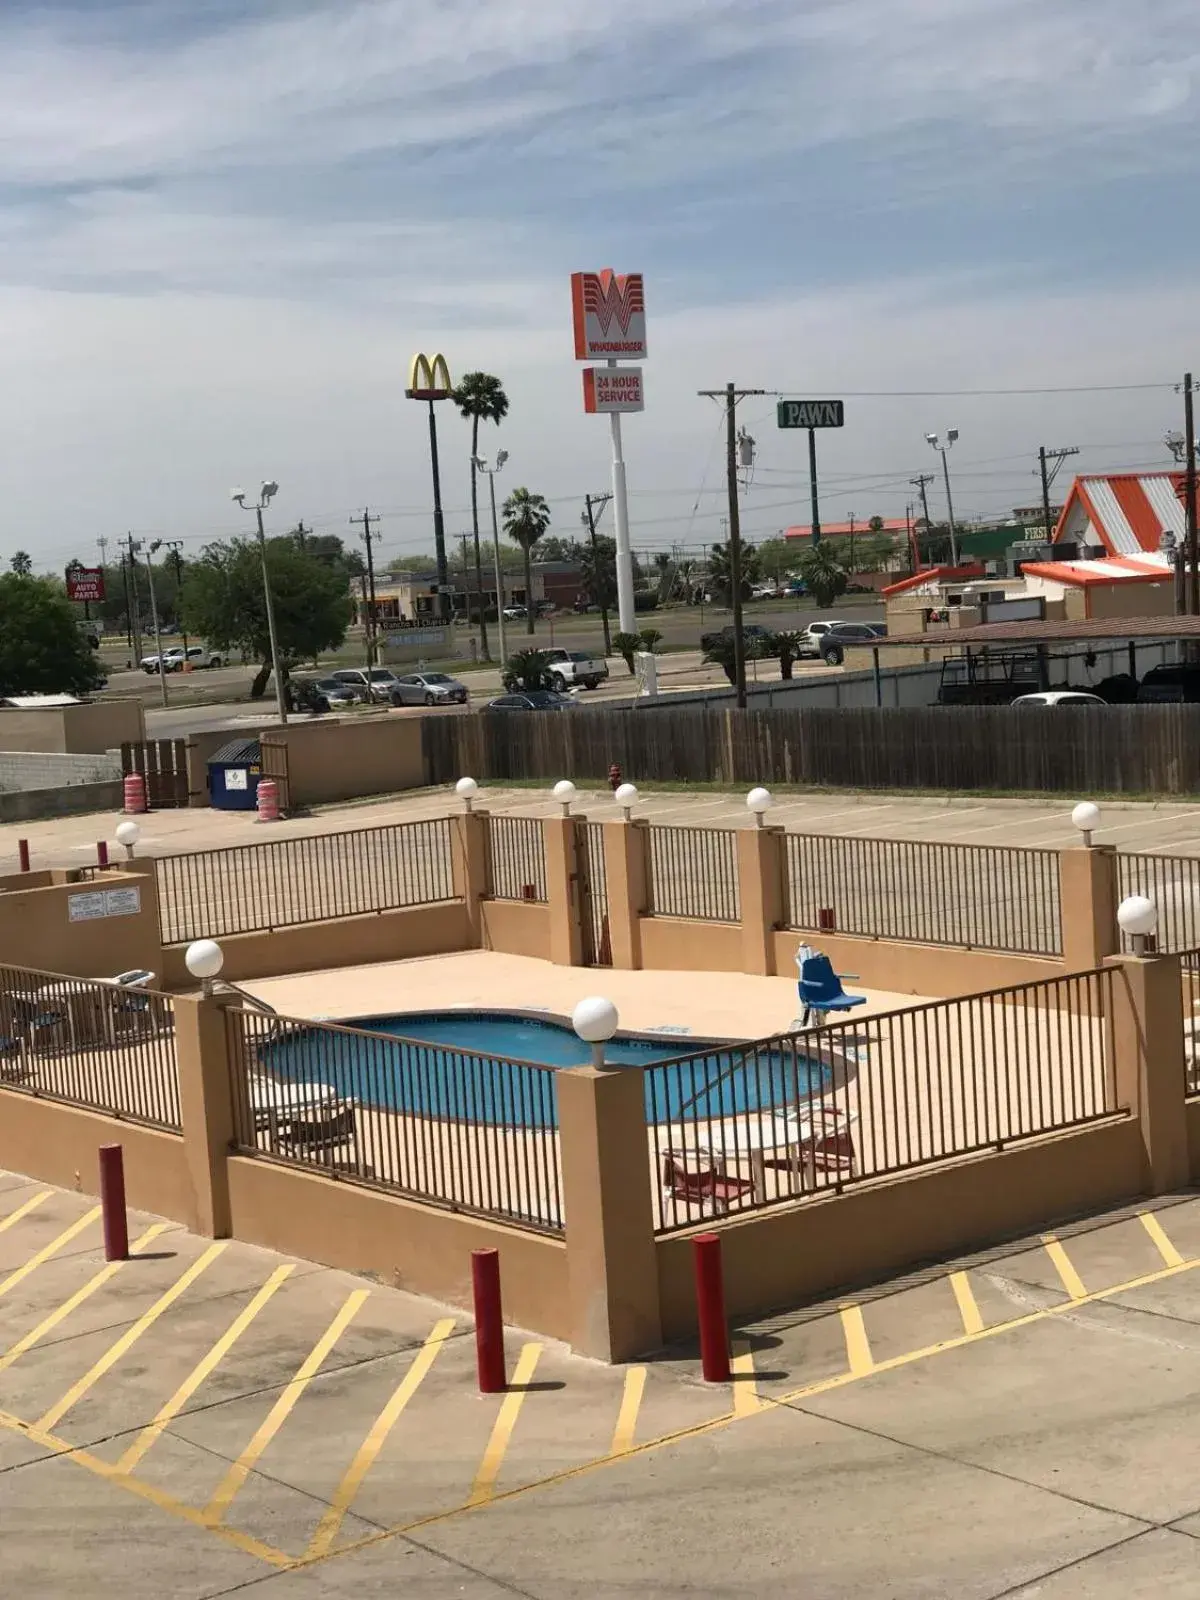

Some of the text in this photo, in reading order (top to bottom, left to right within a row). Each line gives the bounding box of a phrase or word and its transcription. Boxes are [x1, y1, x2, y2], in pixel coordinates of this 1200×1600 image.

[589, 341, 643, 352] WHATABURGER
[598, 376, 640, 388] 24 HOUR
[598, 389, 641, 402] SERVICE
[788, 403, 838, 426] PAWN
[75, 583, 97, 592] AUTO
[74, 591, 100, 600] PARTS
